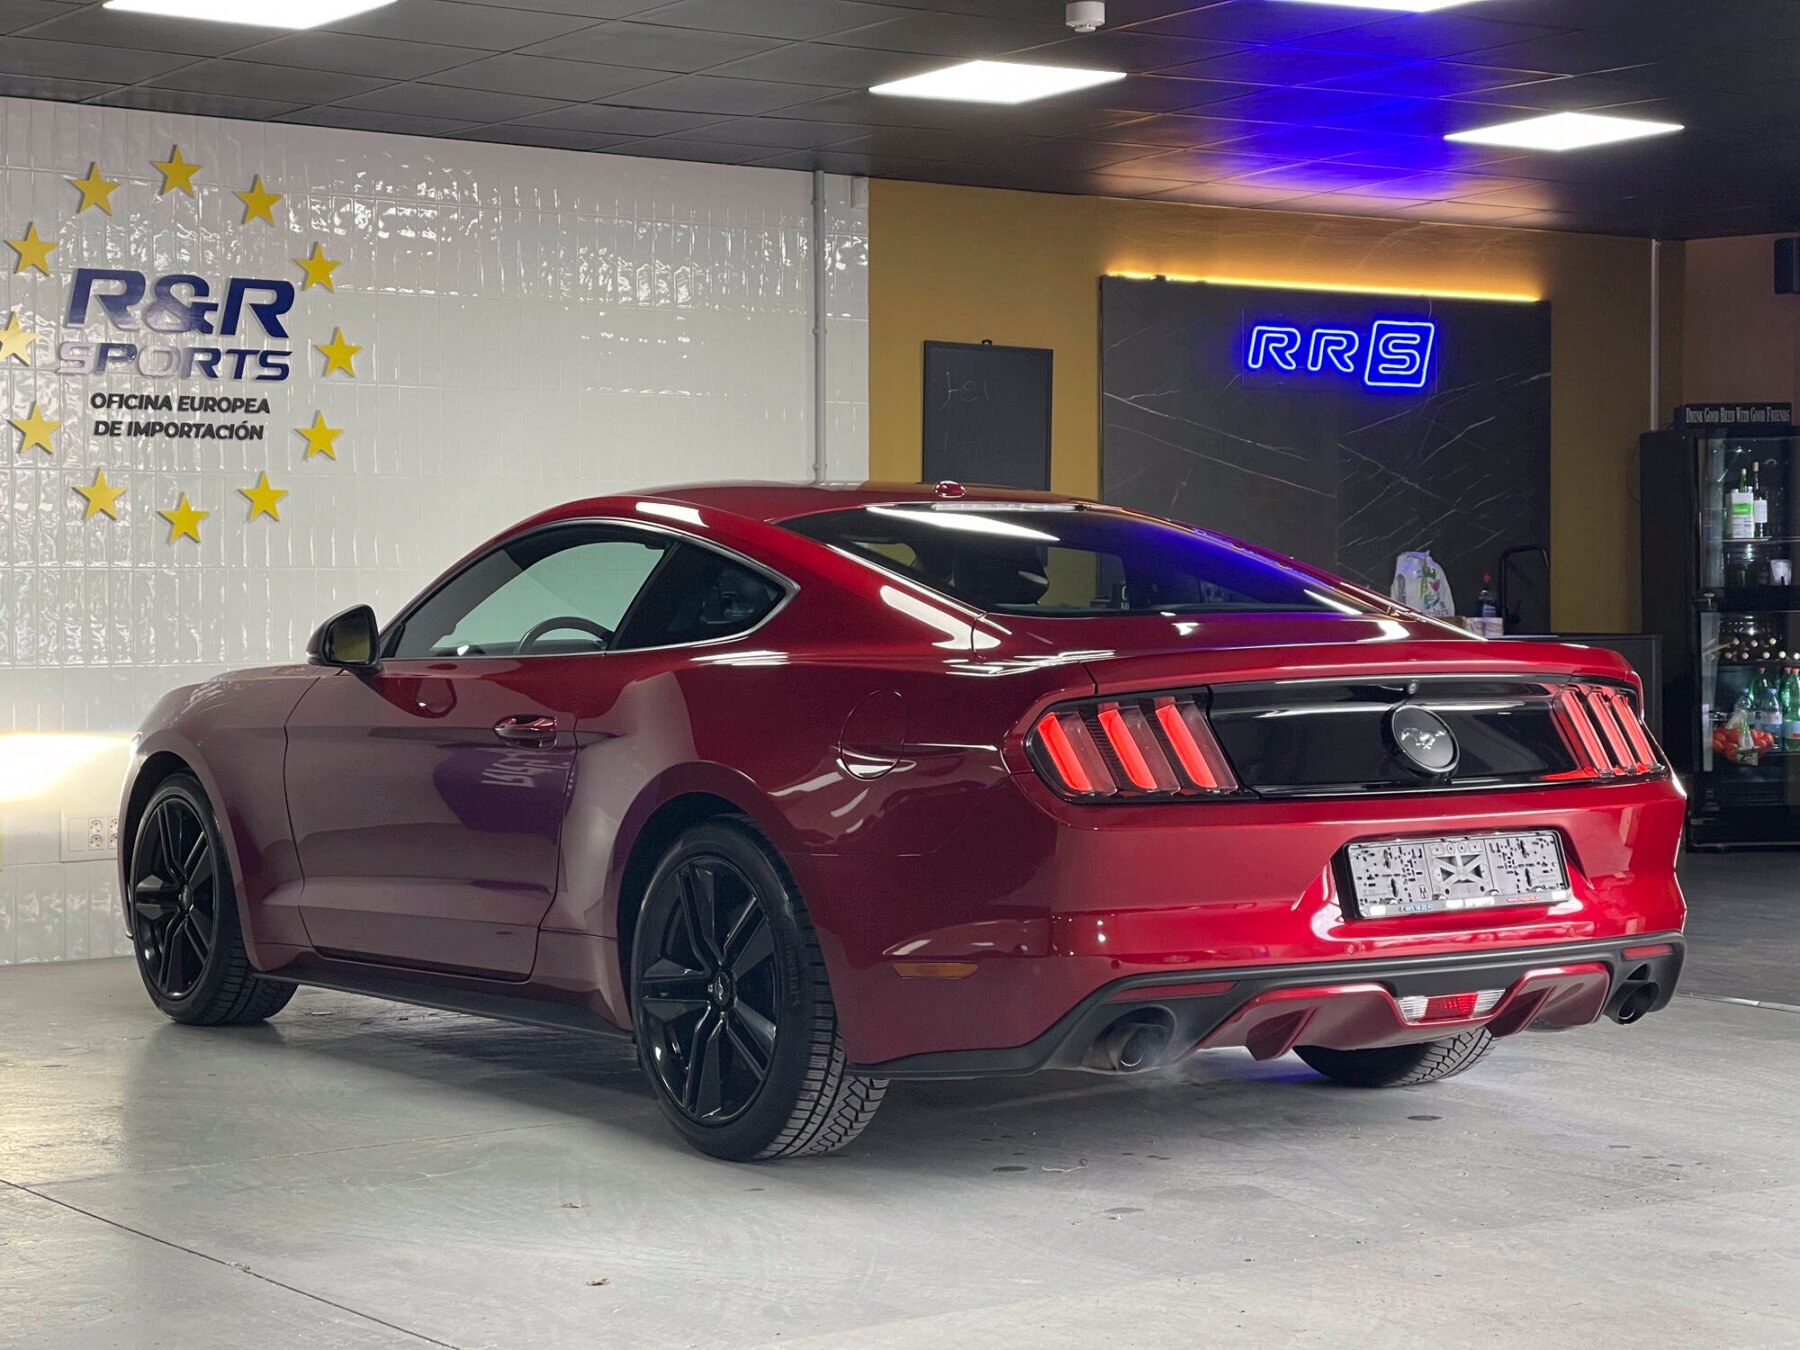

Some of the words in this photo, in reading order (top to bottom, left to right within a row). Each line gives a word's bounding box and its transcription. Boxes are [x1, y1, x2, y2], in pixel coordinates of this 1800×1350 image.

[65, 268, 295, 339] R&R
[57, 341, 293, 382] SPORTS
[90, 392, 172, 412] OFICINA
[177, 395, 271, 414] EUROPEA
[93, 420, 122, 437] DE
[127, 420, 264, 441] IMPORTACIÓN
